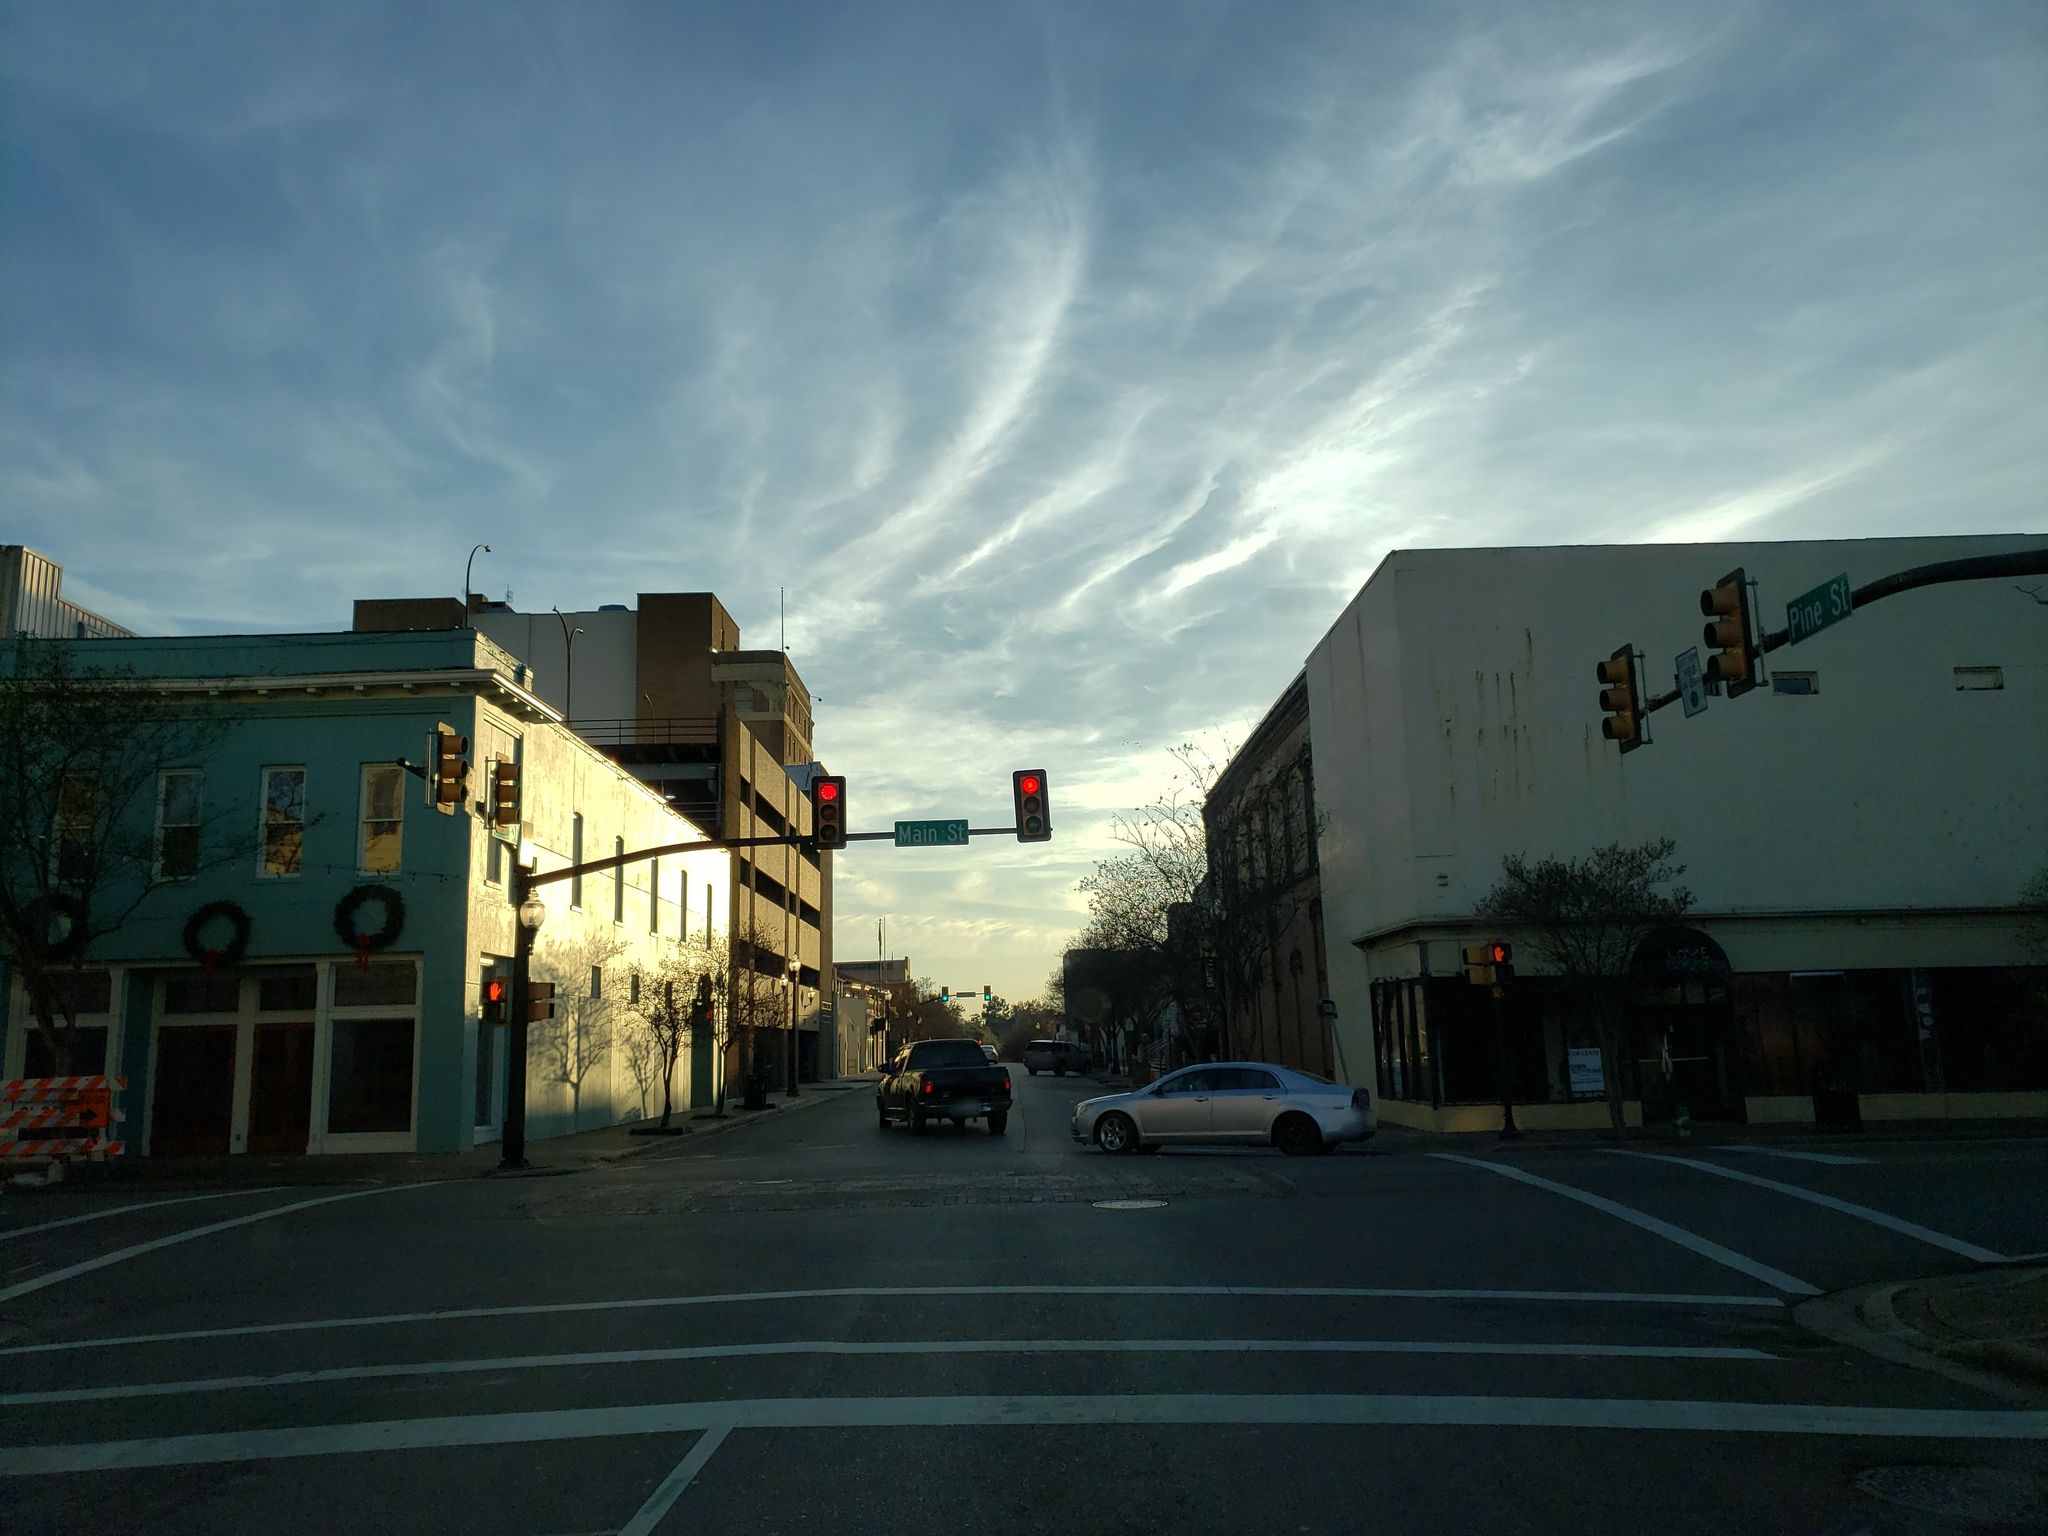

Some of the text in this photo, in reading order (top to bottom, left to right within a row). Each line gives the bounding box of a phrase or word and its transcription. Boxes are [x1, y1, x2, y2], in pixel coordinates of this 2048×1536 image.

[1790, 580, 1849, 639] Pine St
[898, 823, 965, 845] Main St
